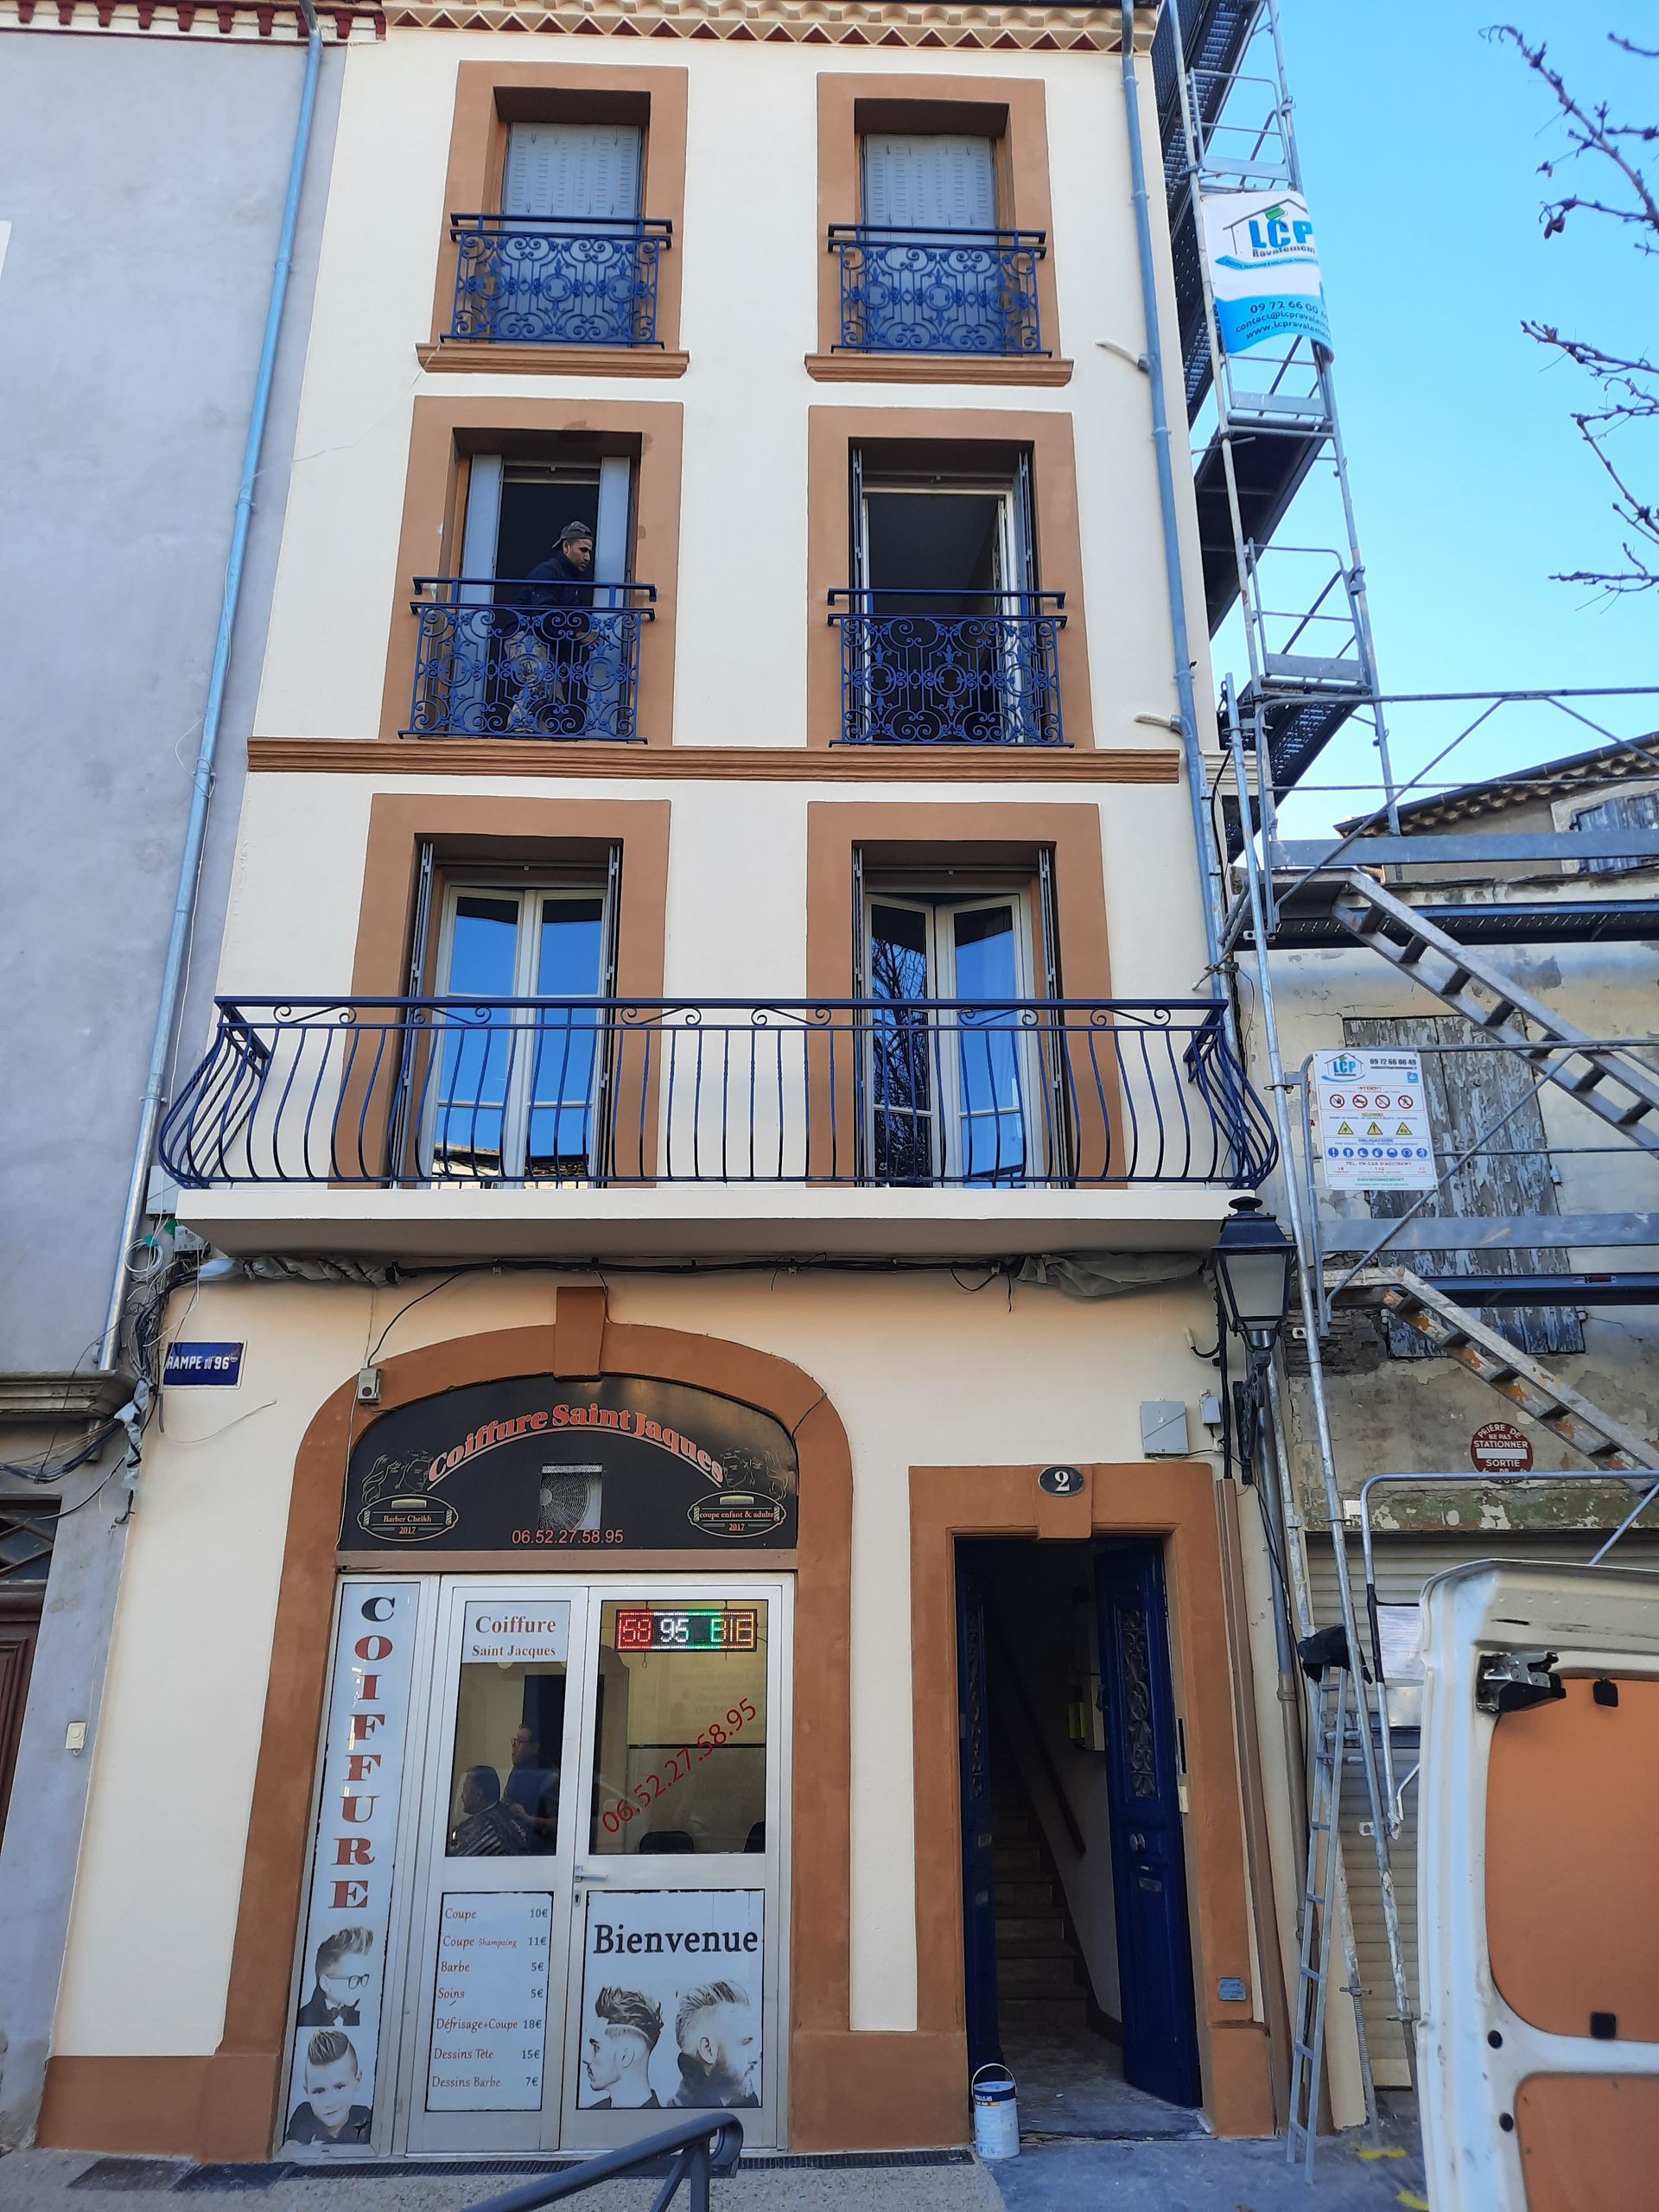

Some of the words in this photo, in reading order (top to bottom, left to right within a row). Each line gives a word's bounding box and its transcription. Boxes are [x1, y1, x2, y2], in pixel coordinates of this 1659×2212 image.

[1248, 219, 1313, 249] LCP
[1249, 302, 1266, 314] 09
[1269, 301, 1285, 309] 72
[1288, 301, 1303, 309] 66
[1305, 303, 1319, 314] 00
[1333, 1060, 1356, 1073] LCP
[166, 1356, 203, 1370] RAMPE
[1510, 1427, 1522, 1439] DE
[428, 1409, 548, 1484] Coiffure
[551, 1402, 632, 1432] Saint
[634, 1410, 724, 1484] Jaques
[1054, 1471, 1070, 1491] 2
[407, 1514, 432, 1522] Cheikh
[699, 1511, 720, 1521] coupe
[753, 1510, 774, 1519] adulte
[398, 1526, 416, 1535] 2017
[728, 1522, 746, 1532] 2017
[512, 1529, 624, 1545] 06.52.27.58.95
[474, 1615, 556, 1635] Coiffure
[622, 1618, 652, 1643] 58
[659, 1618, 690, 1643] 95
[472, 1643, 505, 1657] Saint
[506, 1643, 556, 1660] Jacques
[327, 1596, 396, 1909] COIFFURE
[601, 1696, 758, 1834] 06.52.27.58.95
[444, 1907, 477, 1922] Coupe
[529, 1908, 548, 1920] 10€
[442, 1935, 475, 1949] Coupe
[478, 1937, 518, 1949] Shampoing
[528, 1935, 547, 1948] 11€
[593, 1924, 759, 1955] Bienvenue
[441, 1961, 470, 1974] Barbe
[531, 1961, 545, 1973] 5€
[437, 1987, 466, 2000] Soins
[530, 1988, 544, 2000] 5€
[435, 2017, 518, 2034] Défrisage+Coupe
[523, 2018, 543, 2030] 18€
[434, 2047, 474, 2061] Dessins
[521, 2049, 541, 2061] 15€
[431, 2075, 472, 2088] Dessins
[474, 2074, 501, 2088] Barbe
[525, 2076, 539, 2088] 7€
